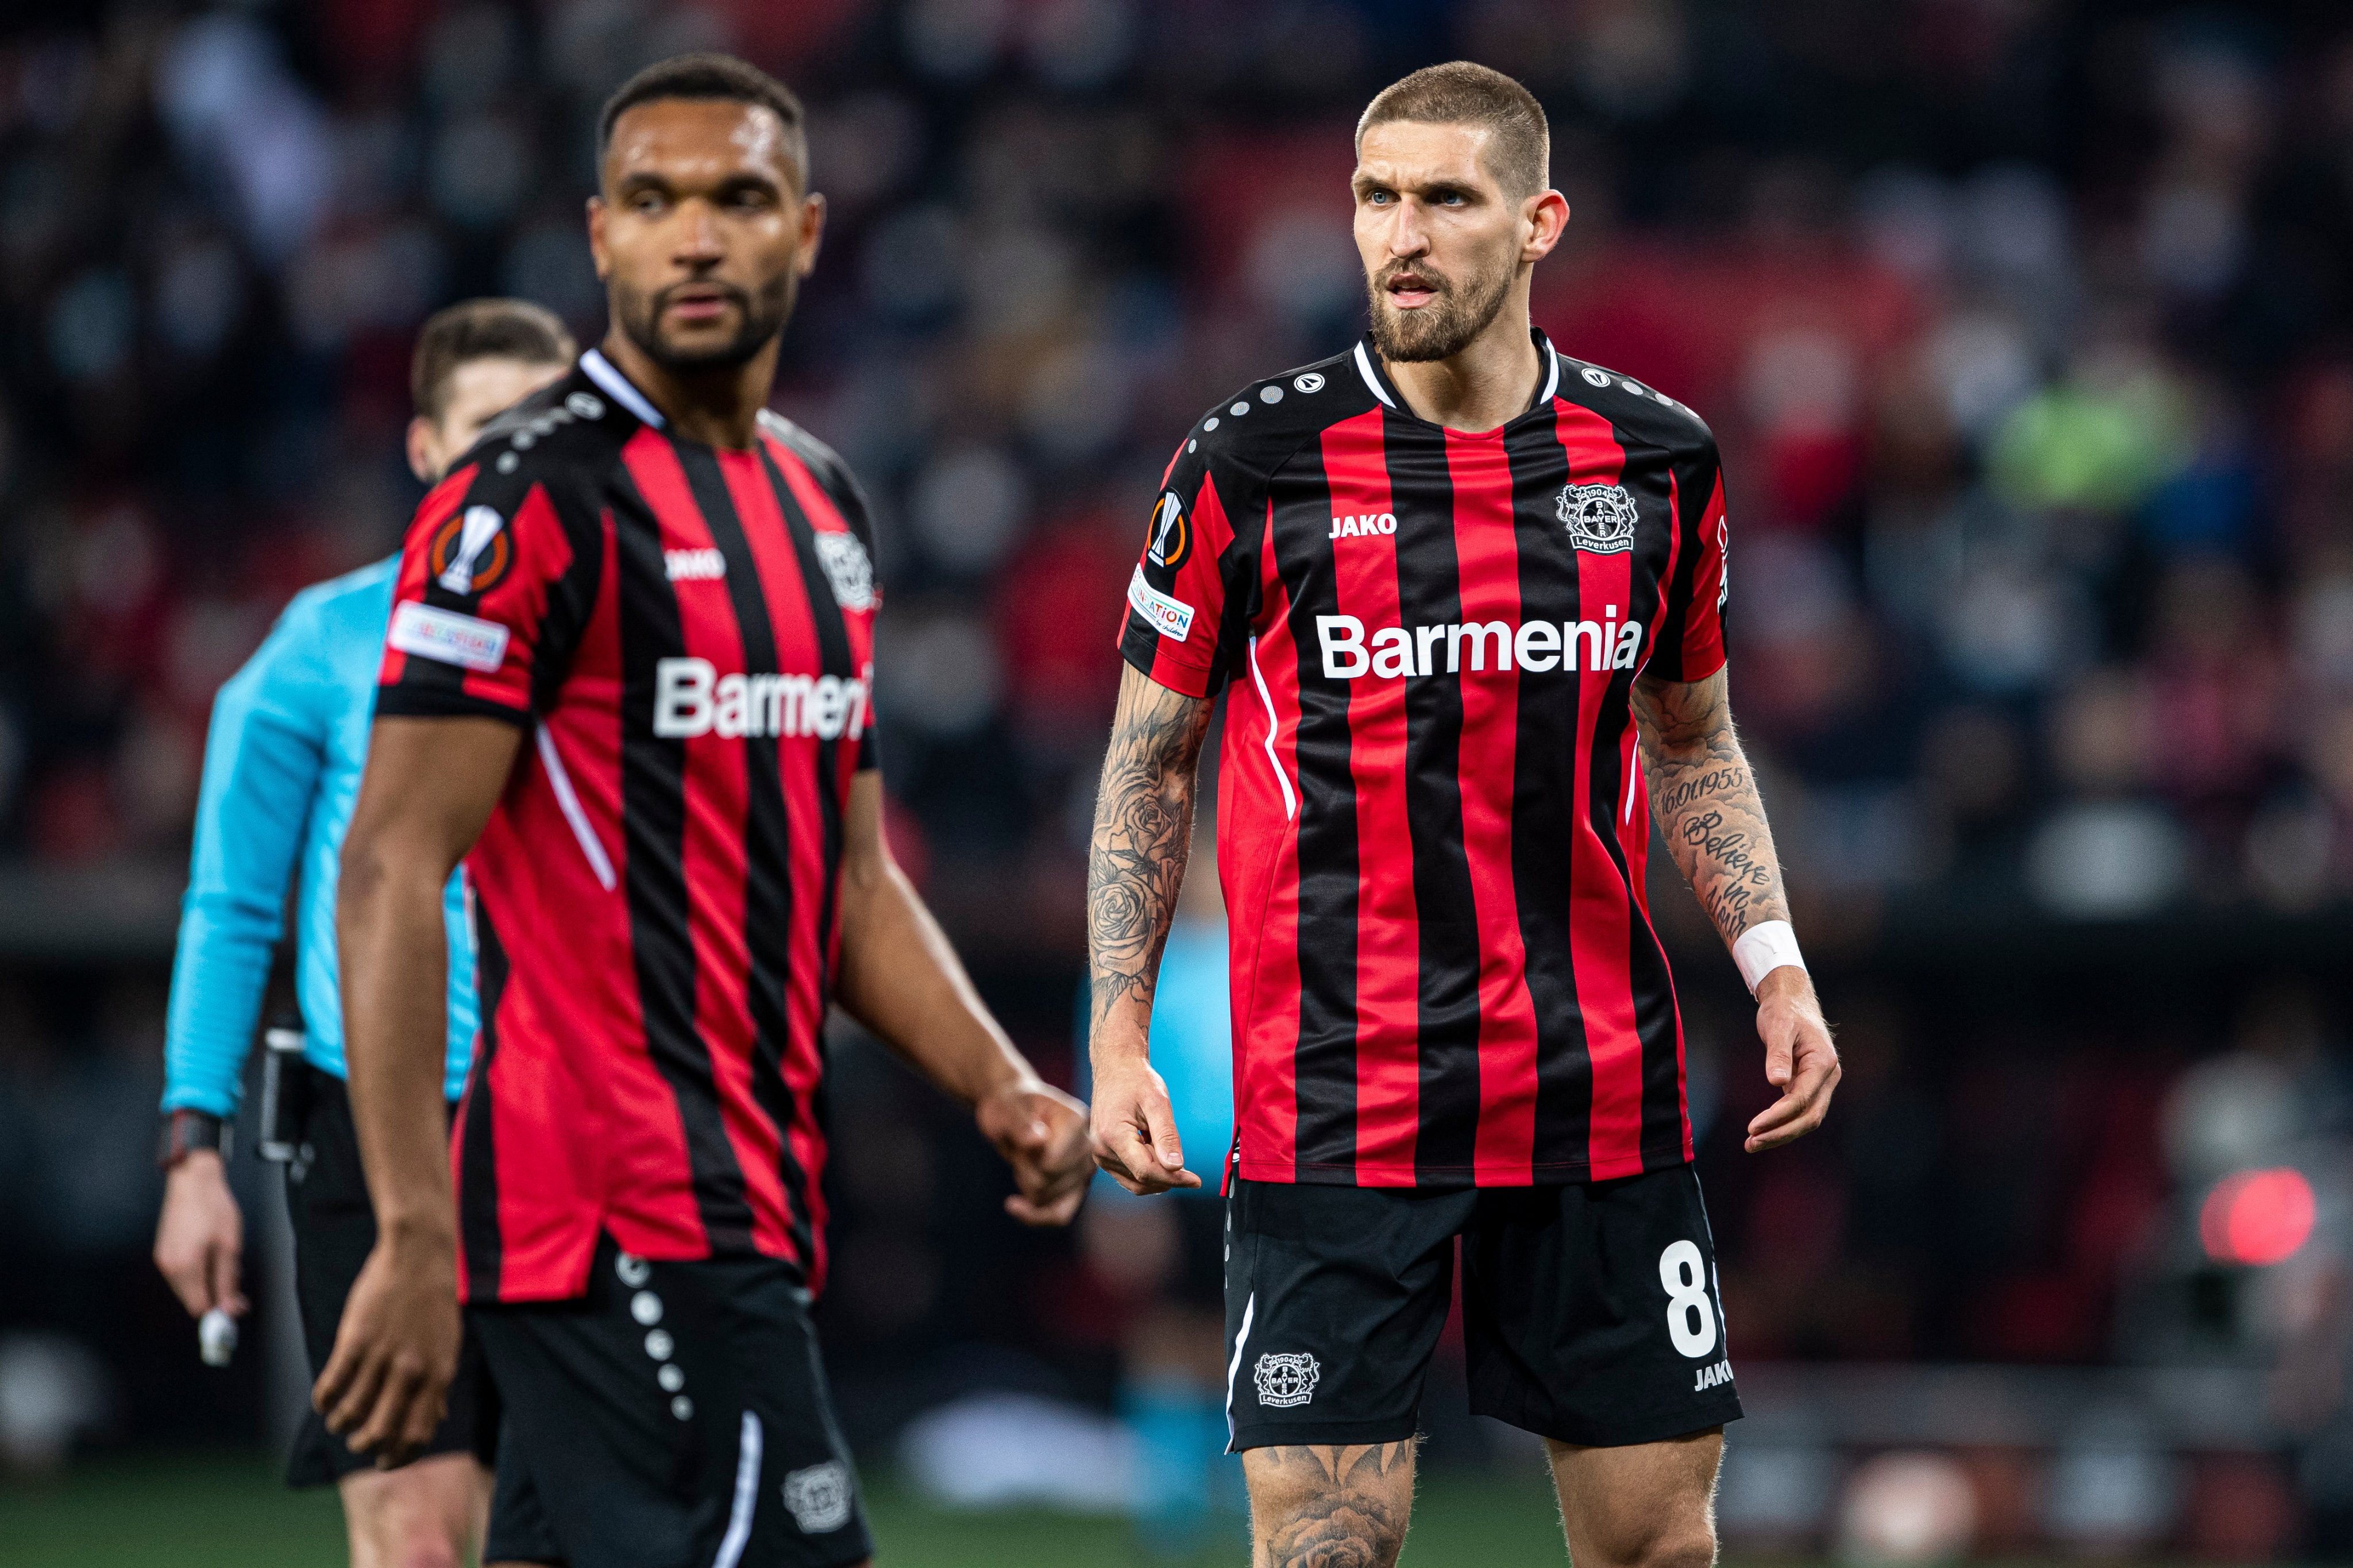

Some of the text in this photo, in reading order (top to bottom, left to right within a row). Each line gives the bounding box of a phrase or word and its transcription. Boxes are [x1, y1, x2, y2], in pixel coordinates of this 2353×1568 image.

[1587, 489, 1607, 498] 1904
[1329, 513, 1397, 539] JAKO
[1584, 515, 1617, 523] BAYER
[1595, 501, 1607, 537] BAYER
[1576, 536, 1629, 550] Leverkusen
[1162, 624, 1183, 638] children
[1316, 605, 1642, 679] Barmenia
[1661, 767, 1743, 816] 16.01.1955
[1683, 810, 1770, 885] Believe
[1724, 875, 1750, 912] in
[1658, 1239, 1716, 1358] 8
[1263, 1395, 1307, 1405] Leverkusen
